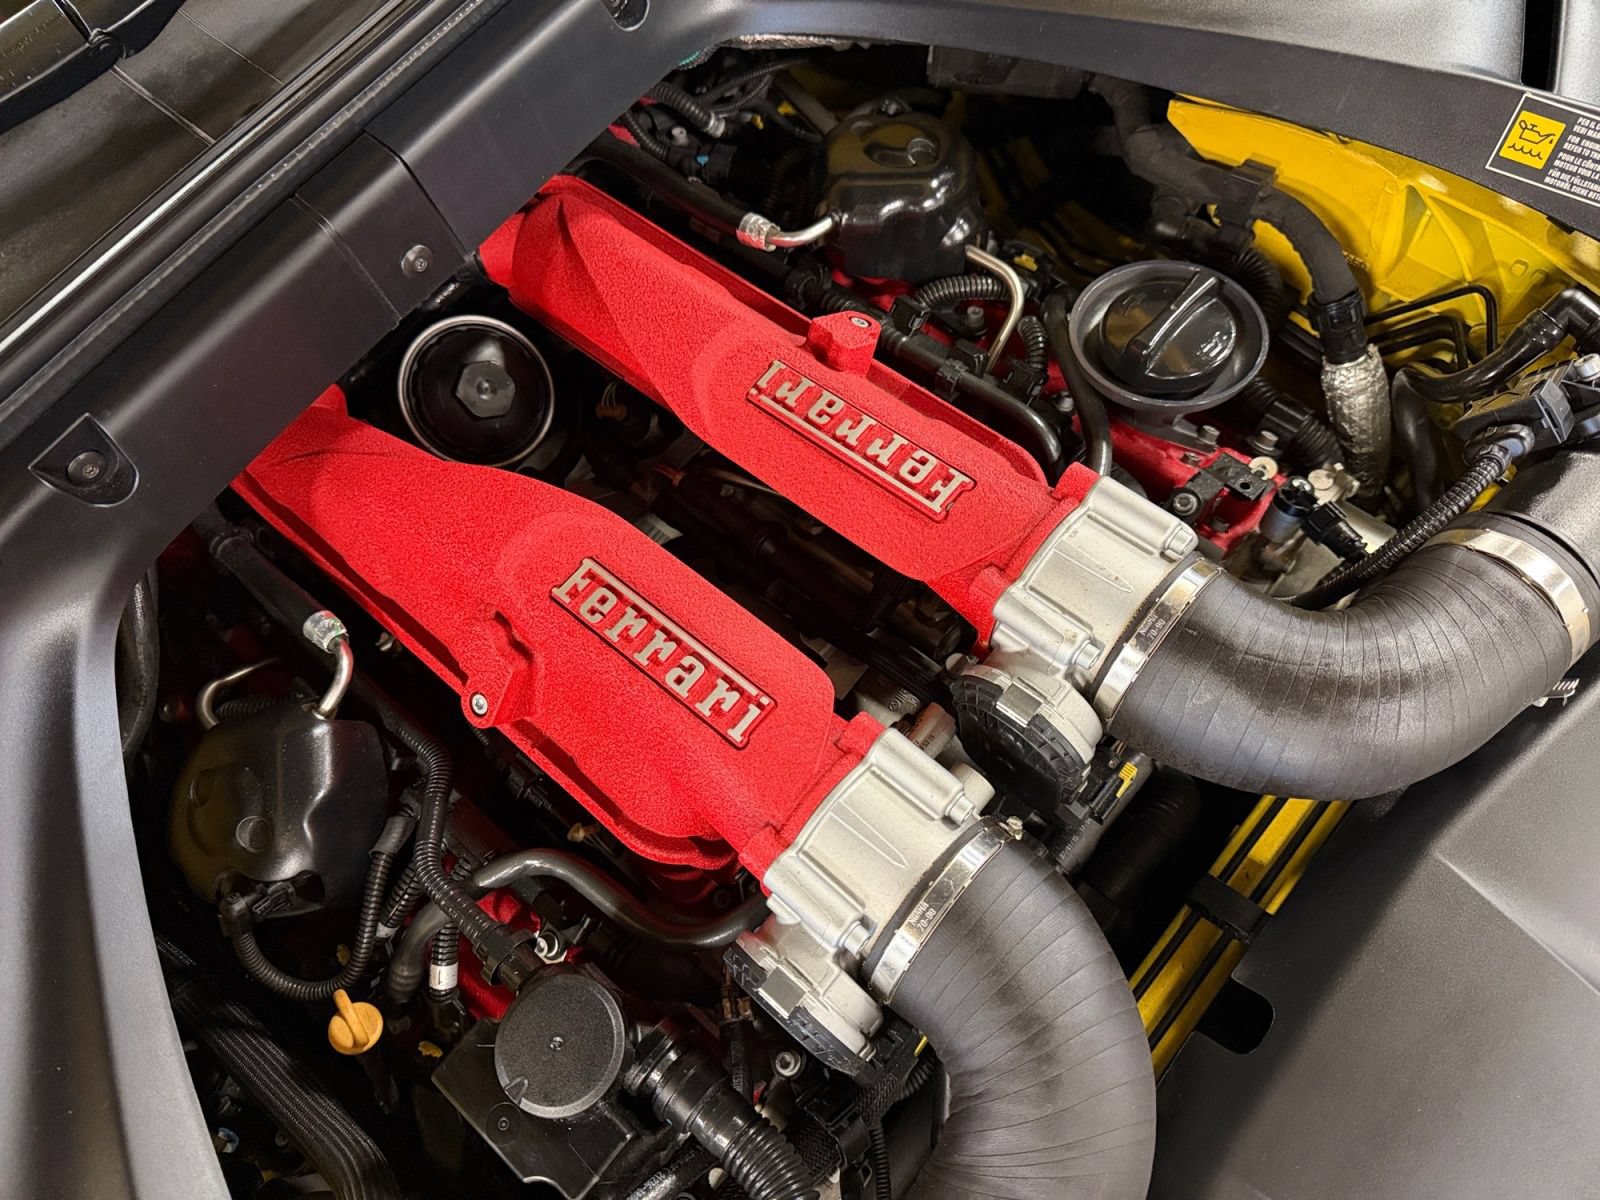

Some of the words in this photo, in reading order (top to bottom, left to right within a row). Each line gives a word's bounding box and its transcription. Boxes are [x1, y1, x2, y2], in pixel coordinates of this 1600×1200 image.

[1577, 116, 1590, 127] PER
[1567, 134, 1581, 144] FOR
[1557, 151, 1575, 162] POUR
[1573, 157, 1583, 165] LE
[1563, 142, 1583, 153] REFER
[1582, 148, 1591, 157] TO
[1548, 168, 1561, 178] FÜR
[1560, 173, 1571, 182] DIE
[1553, 159, 1578, 172] MOTEUR
[1577, 167, 1592, 177] VOIR
[1544, 176, 1571, 190] MOTORÖL
[1571, 185, 1589, 196] SIEHE
[750, 359, 971, 513] Ferrari
[1146, 618, 1166, 640] 70-90
[551, 557, 770, 743] Ferrari
[916, 907, 937, 932] 70-90
